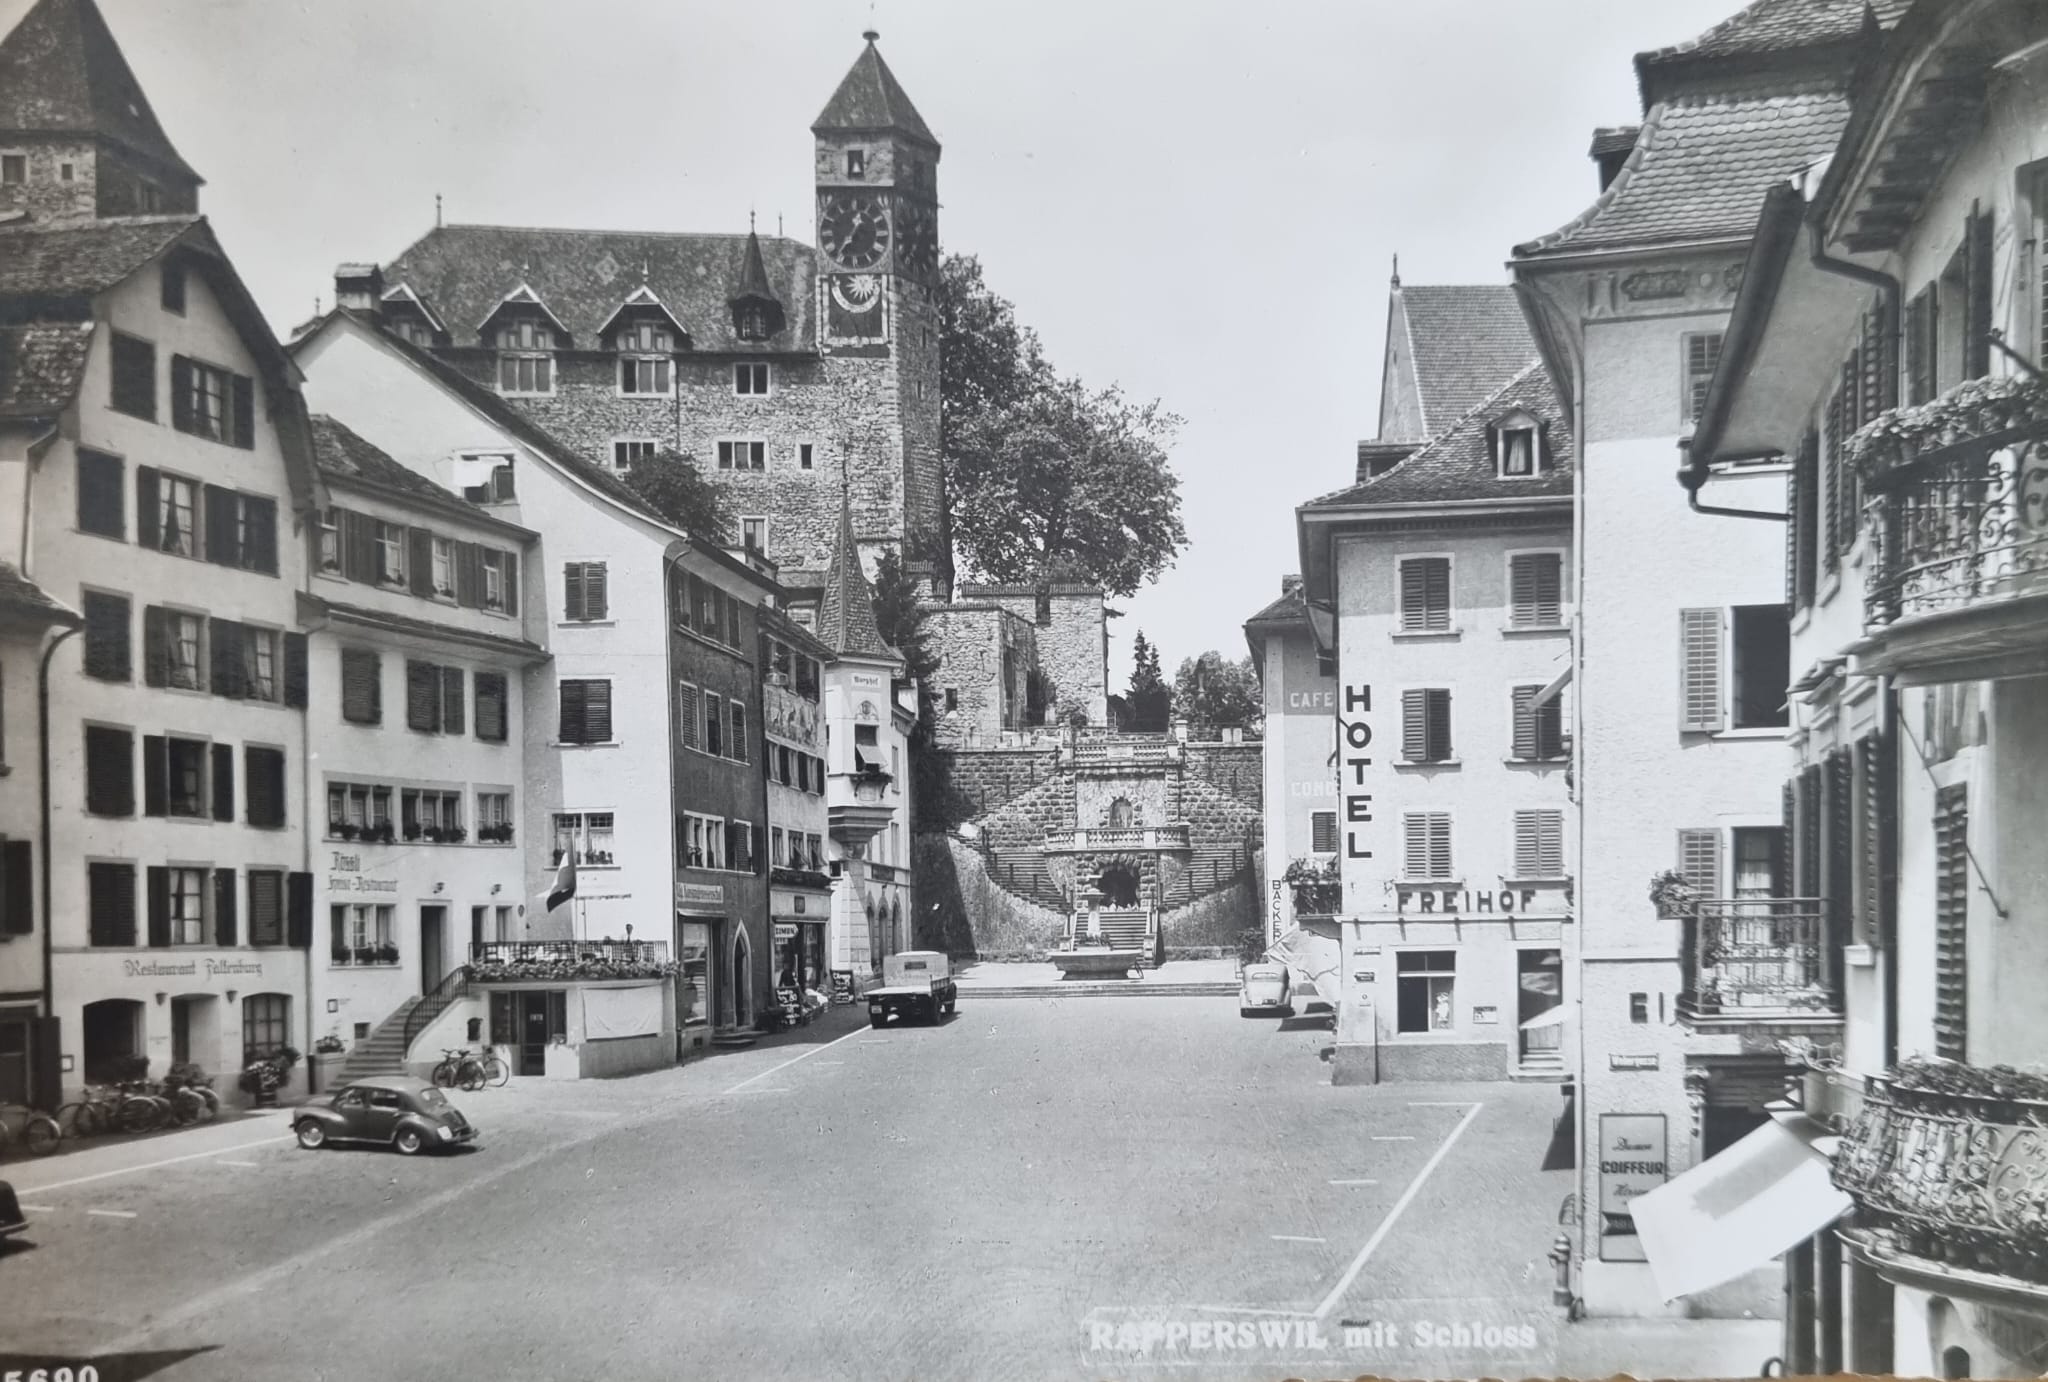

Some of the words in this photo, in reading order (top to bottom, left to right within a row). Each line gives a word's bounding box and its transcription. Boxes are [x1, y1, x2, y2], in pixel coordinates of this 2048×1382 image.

[1346, 685, 1373, 859] HOTEL
[1397, 889, 1536, 913] FREIHOF
[123, 959, 196, 977] Restaurant
[1601, 1161, 1664, 1175] COIFFEUR
